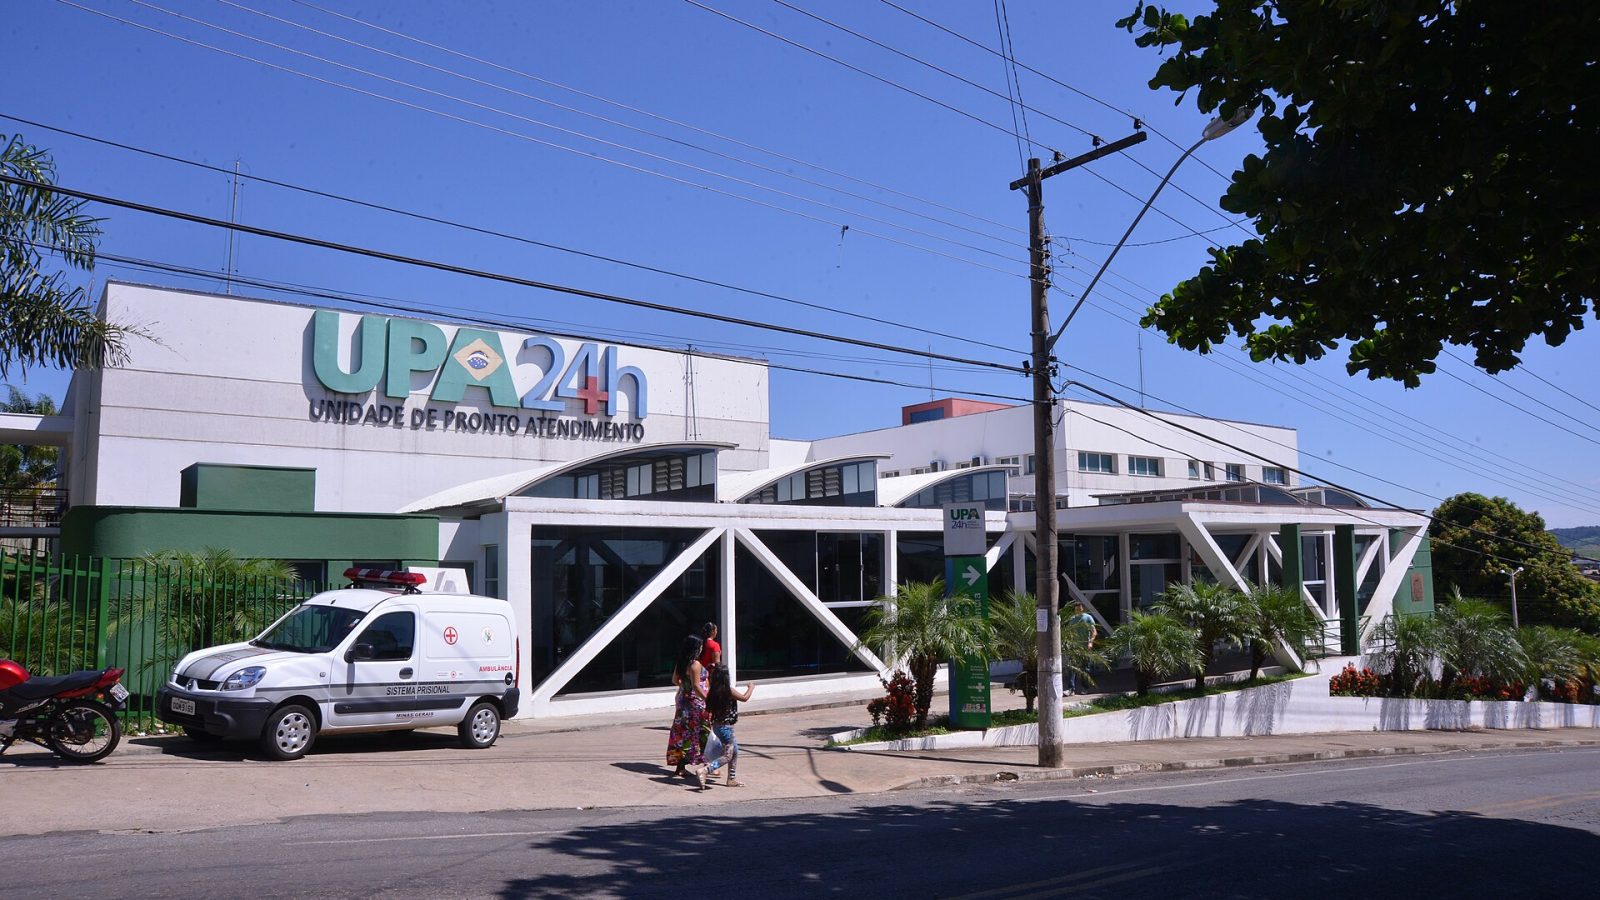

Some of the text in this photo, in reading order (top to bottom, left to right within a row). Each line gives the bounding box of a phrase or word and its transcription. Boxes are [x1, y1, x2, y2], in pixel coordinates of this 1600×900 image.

[313, 309, 648, 420] UPA 24h
[310, 398, 646, 442] UNIDADE DE PRONTO ATENDIMENTO
[951, 508, 980, 520] UPA
[952, 520, 967, 529] 24h
[386, 685, 450, 696] SISTEMA PRISIONAL
